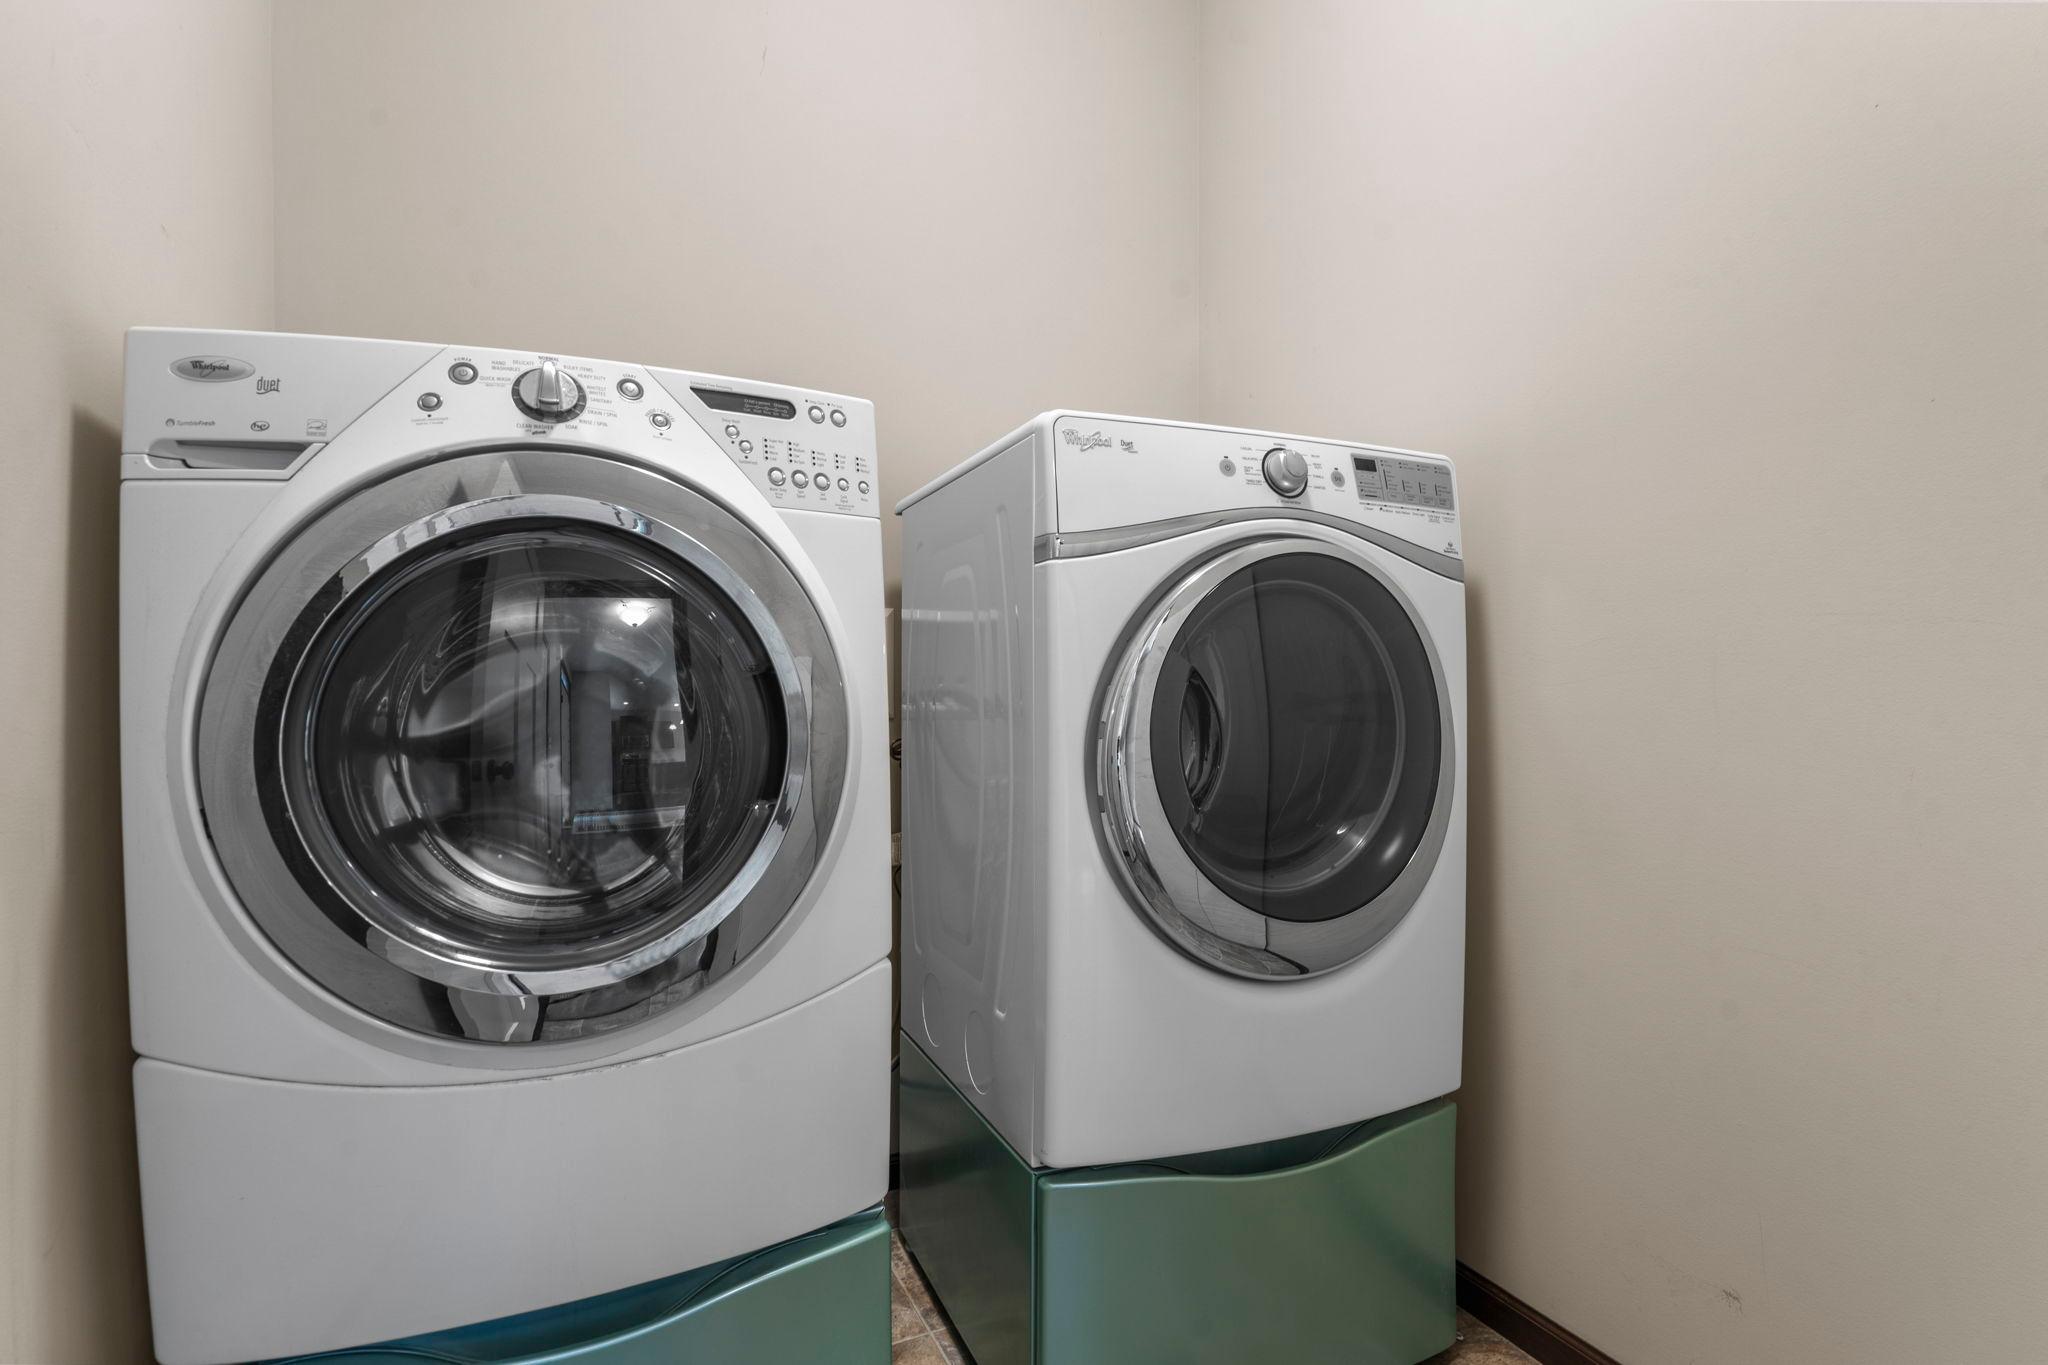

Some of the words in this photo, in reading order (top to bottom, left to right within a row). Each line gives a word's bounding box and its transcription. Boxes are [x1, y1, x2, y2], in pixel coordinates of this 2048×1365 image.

[190, 360, 230, 374] Whirlpool
[256, 376, 281, 394] duet
[1062, 429, 1112, 450] Whirlpool
